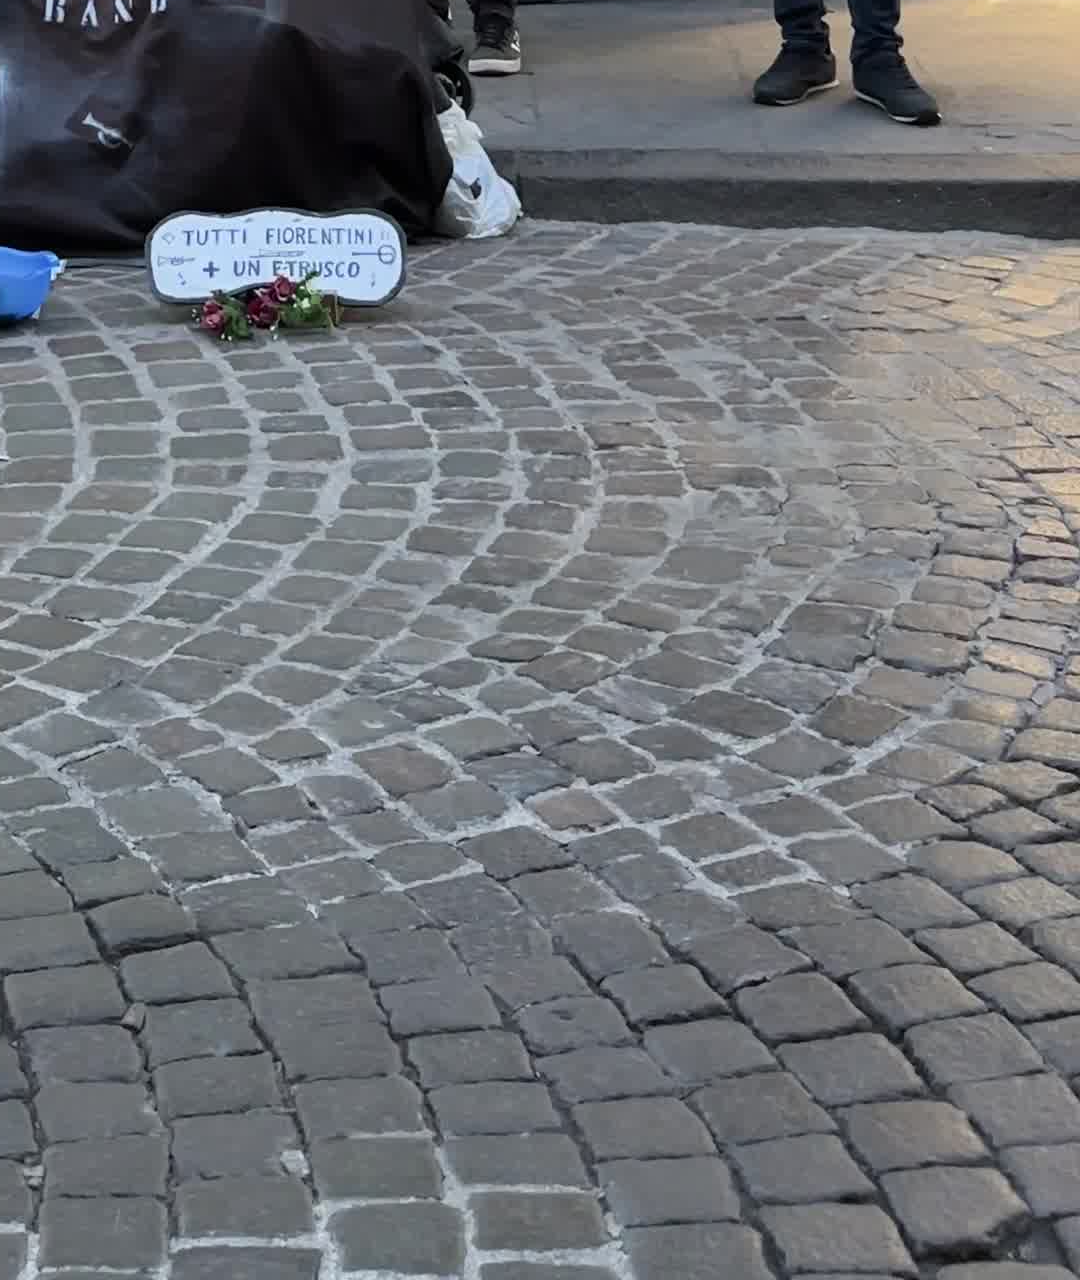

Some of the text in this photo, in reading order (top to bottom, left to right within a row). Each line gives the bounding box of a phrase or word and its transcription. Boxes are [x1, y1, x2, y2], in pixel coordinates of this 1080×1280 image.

[183, 227, 373, 247] TUTTI FIORENTINI
[232, 259, 261, 278] UN
[272, 260, 361, 279] ETRUSCO
